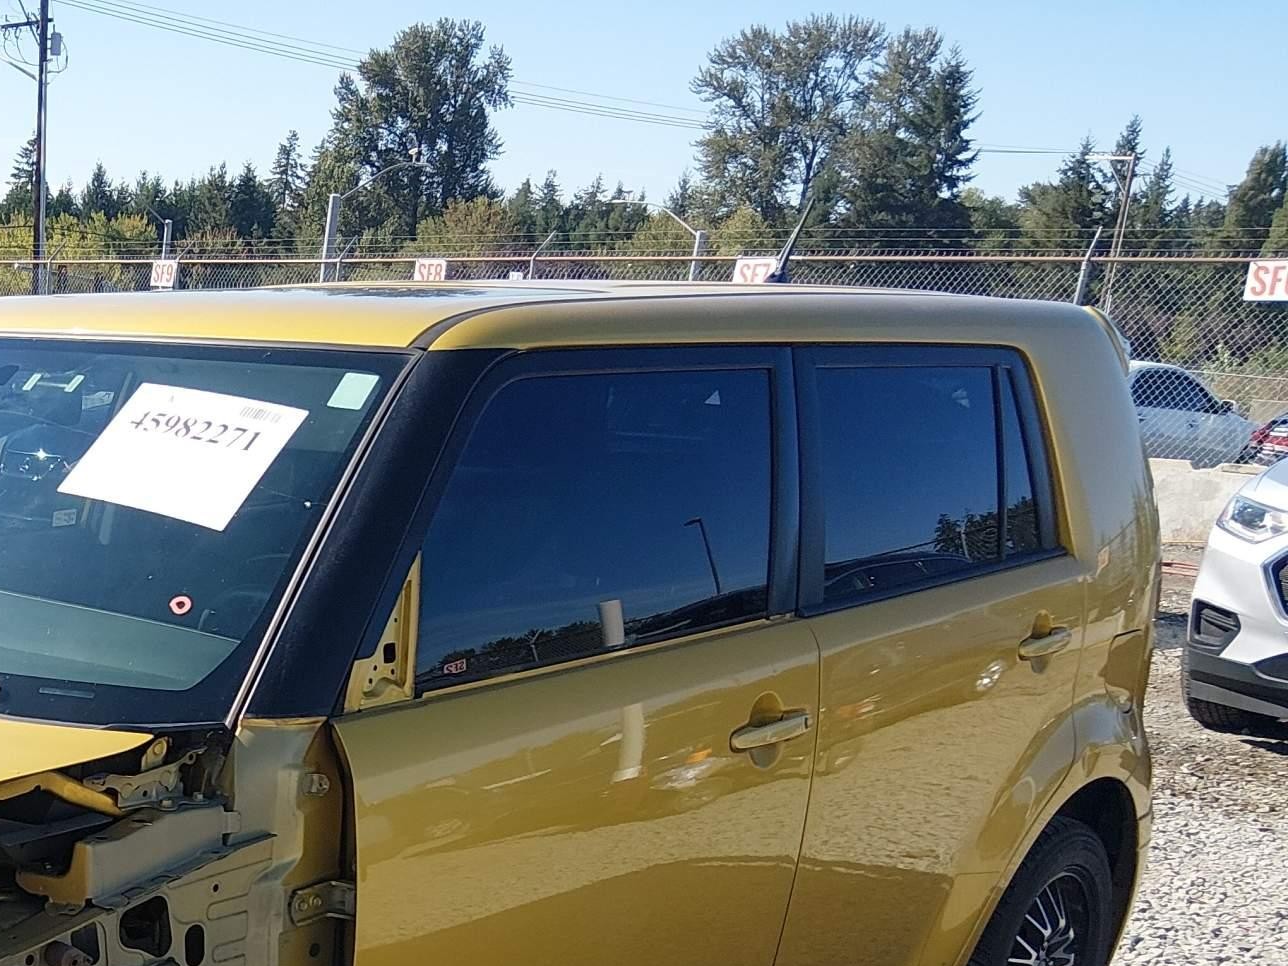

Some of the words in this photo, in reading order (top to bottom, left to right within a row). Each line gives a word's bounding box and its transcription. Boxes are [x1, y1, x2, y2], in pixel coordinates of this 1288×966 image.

[153, 263, 173, 283] SF9
[418, 263, 443, 280] SF8
[740, 263, 771, 282] SF7
[131, 411, 261, 450] 45982271
